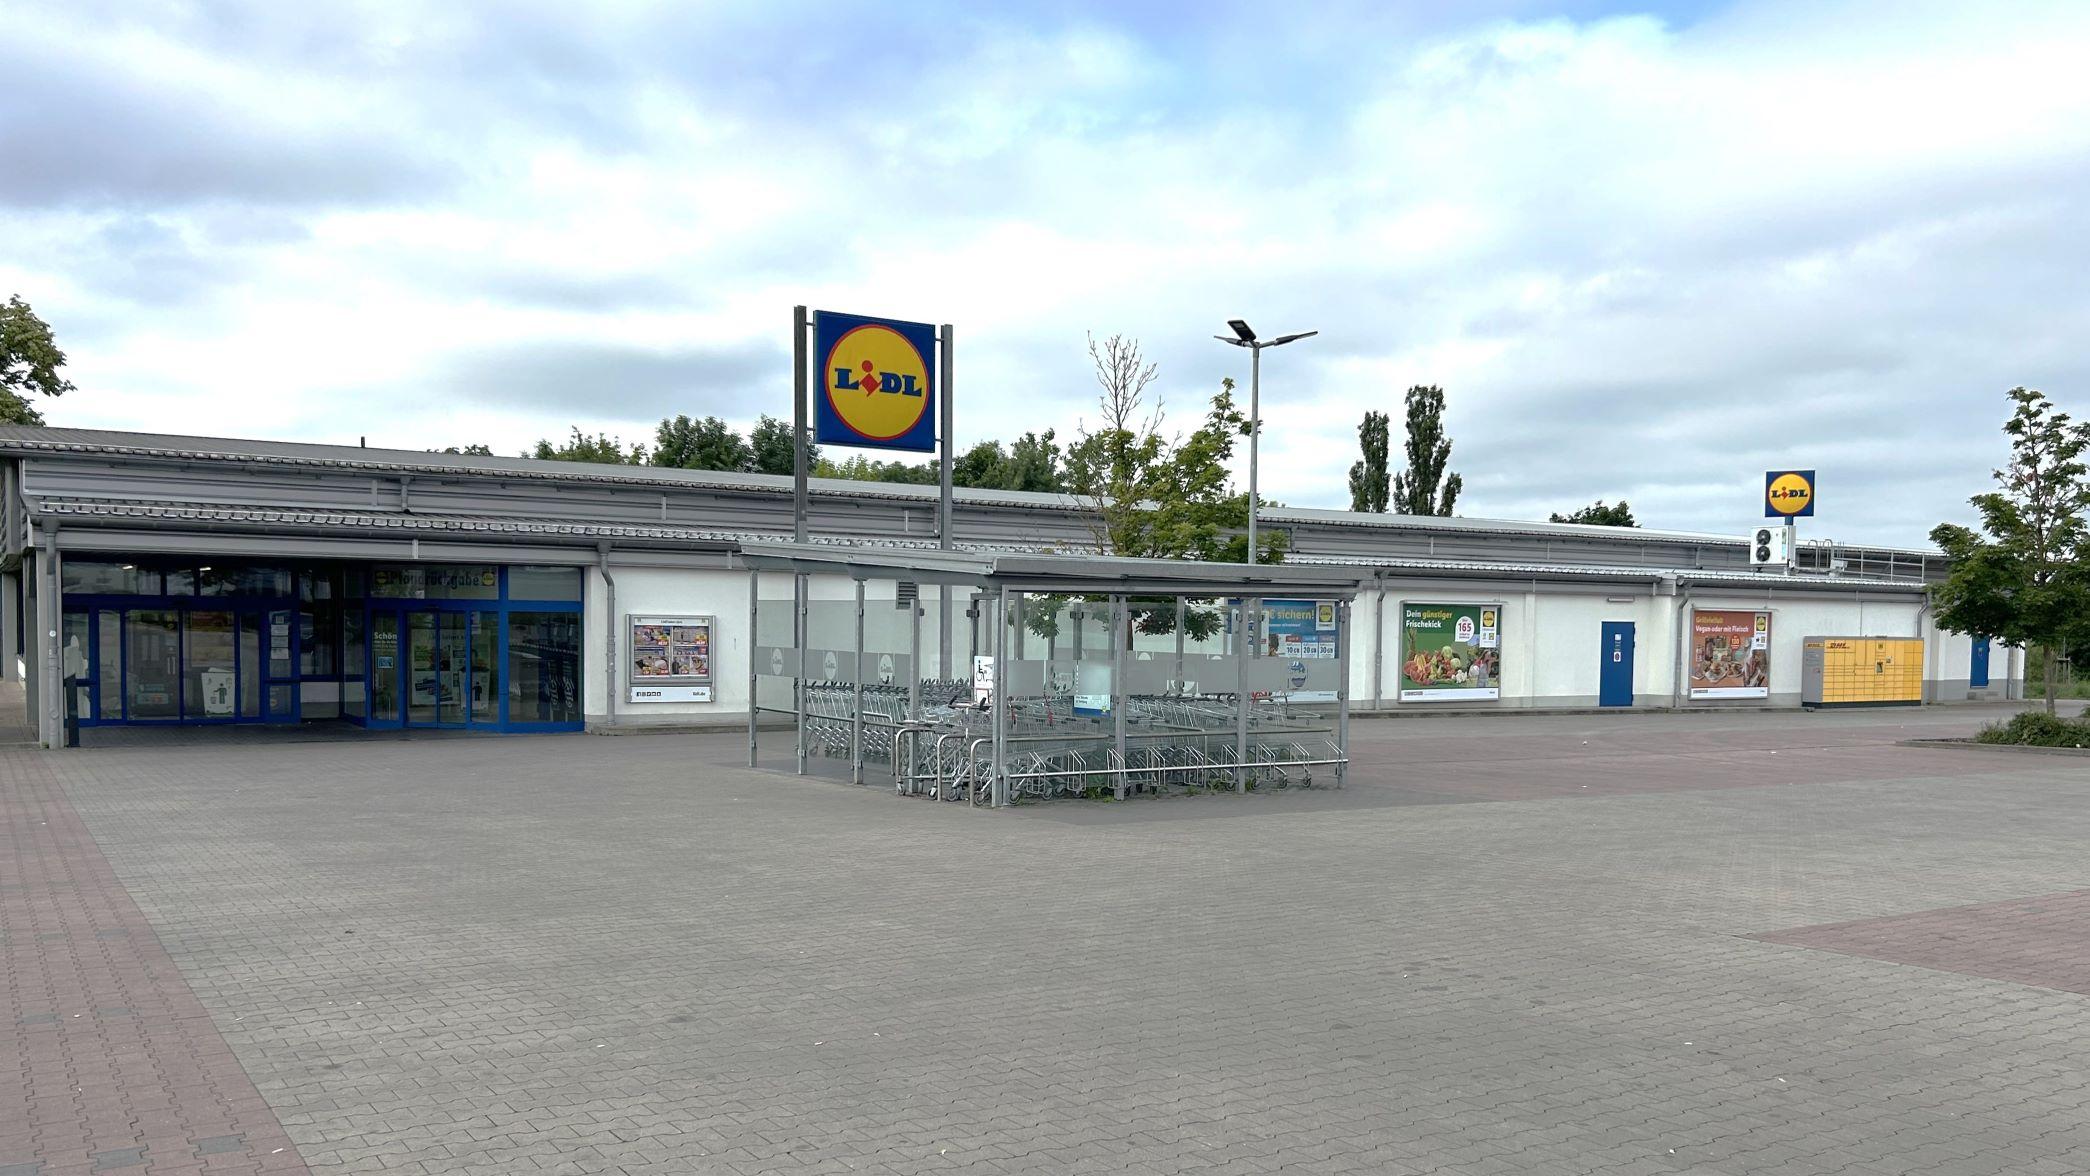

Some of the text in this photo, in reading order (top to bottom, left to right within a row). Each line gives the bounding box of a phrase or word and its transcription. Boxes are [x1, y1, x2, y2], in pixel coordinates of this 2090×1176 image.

[1277, 609, 1315, 620] sichern!
[1406, 609, 1422, 618] Dein
[1422, 610, 1453, 620] günstiger
[1405, 620, 1442, 628] Frischekick
[1458, 622, 1472, 632] 165
[1695, 625, 1711, 633] Vegan
